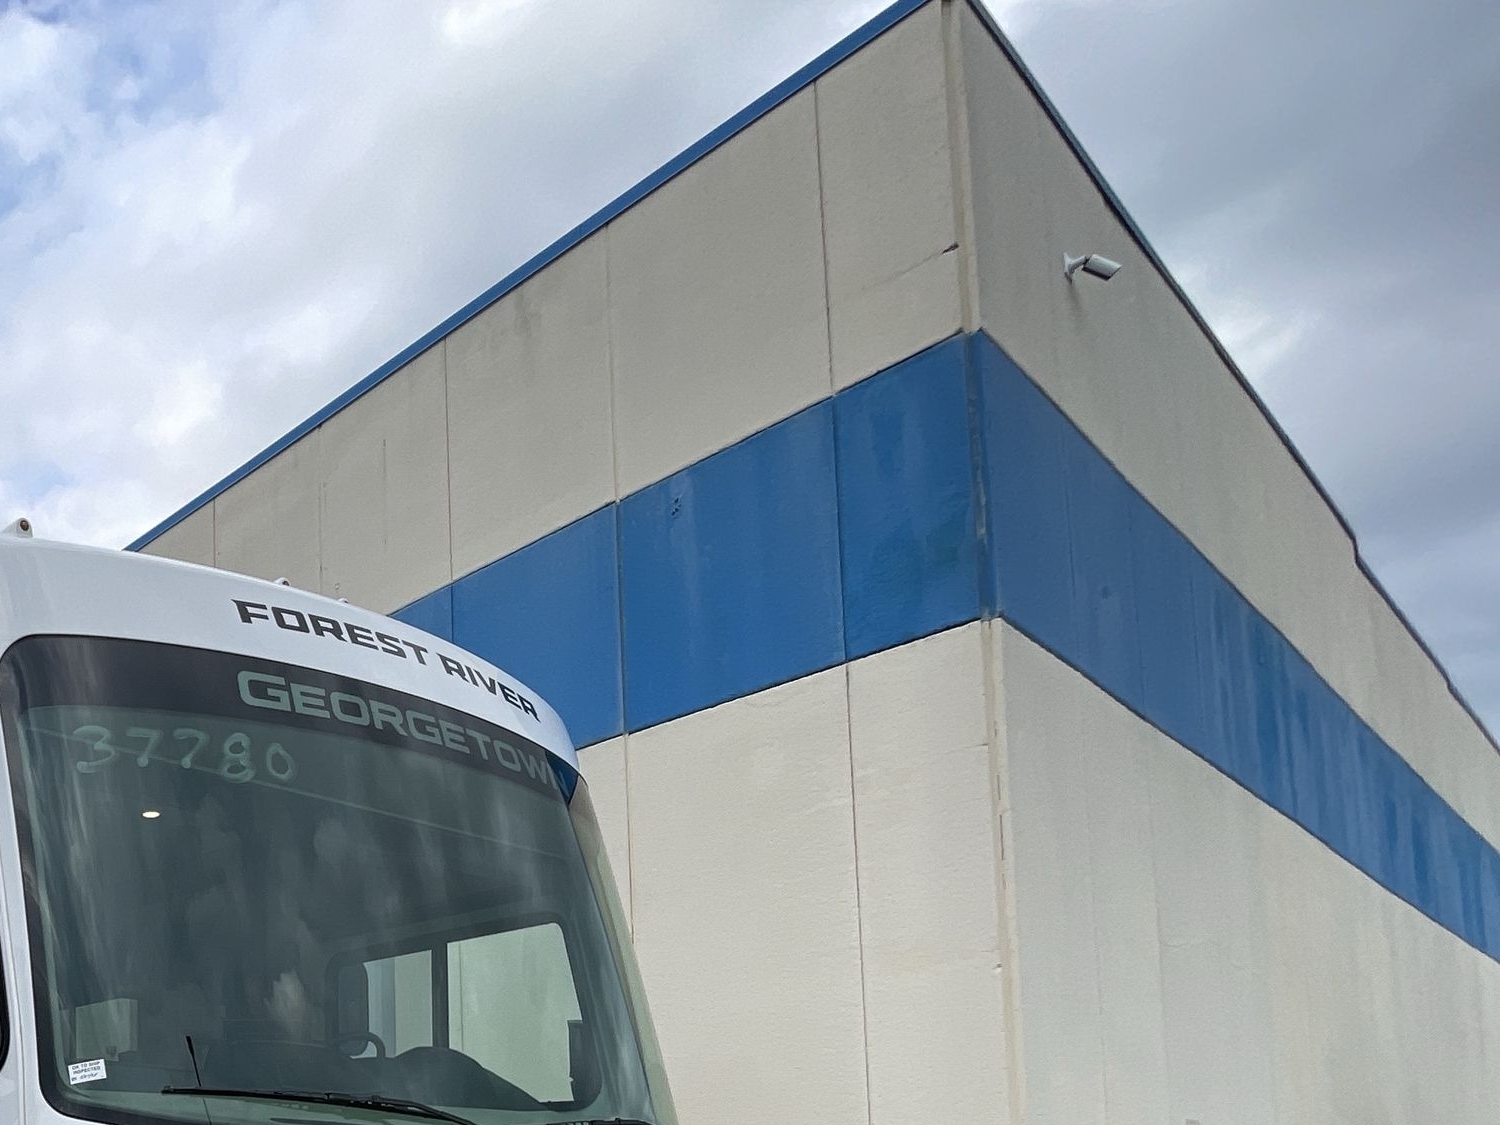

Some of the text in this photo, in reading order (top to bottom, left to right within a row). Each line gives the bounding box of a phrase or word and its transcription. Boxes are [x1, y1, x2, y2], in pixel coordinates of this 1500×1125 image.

[231, 599, 541, 723] FOREST RIVER
[73, 725, 297, 783] 37780
[237, 670, 571, 799] GEORGETOWN
